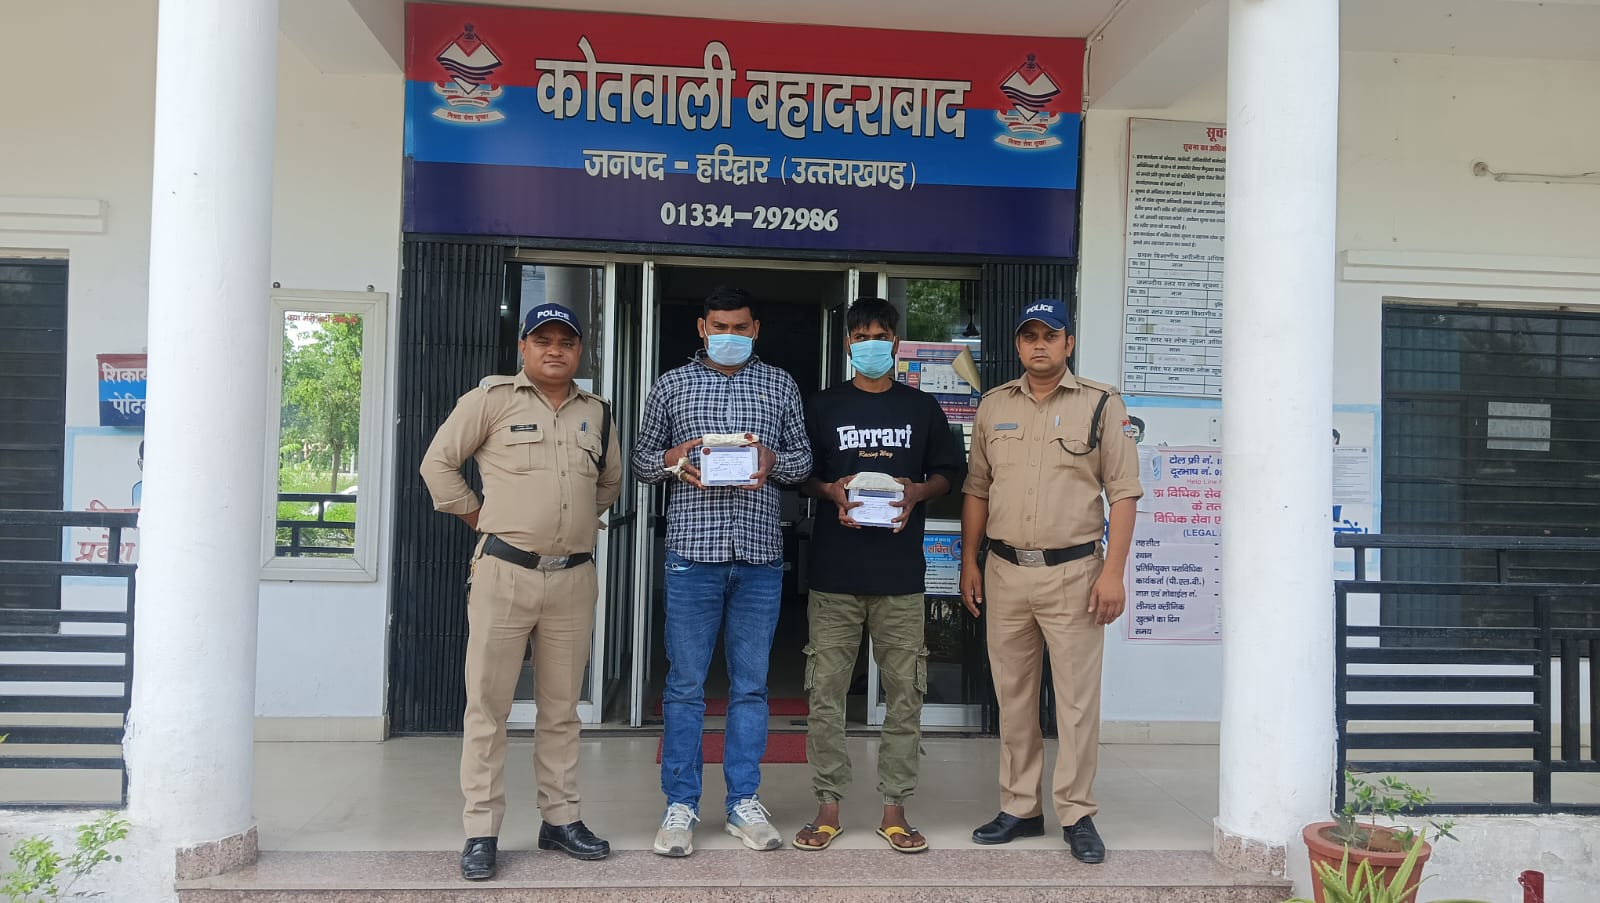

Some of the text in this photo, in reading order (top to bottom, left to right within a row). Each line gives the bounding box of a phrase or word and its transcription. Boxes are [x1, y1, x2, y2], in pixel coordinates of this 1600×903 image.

[535, 35, 972, 139] कोतवाली बहादराबाद
[582, 149, 667, 181] जनपद
[696, 144, 770, 186] हरिद्वार
[660, 201, 839, 232] 01334-292986
[537, 310, 570, 320] POLICE
[1026, 303, 1055, 315] POLICE
[836, 424, 912, 450] Ferrari
[1169, 454, 1186, 464] टोल
[1188, 454, 1200, 466] फ्री
[1170, 468, 1198, 478] दूरभाष
[1168, 486, 1200, 498] विधिक
[1192, 500, 1202, 511] के
[1154, 512, 1188, 524] विधिक
[1191, 513, 1210, 524] सेवा
[1184, 529, 1217, 537] (LEGAL
[1136, 538, 1160, 547] तहसील
[1136, 601, 1156, 610] लीगल
[1168, 614, 1180, 623] दिन
